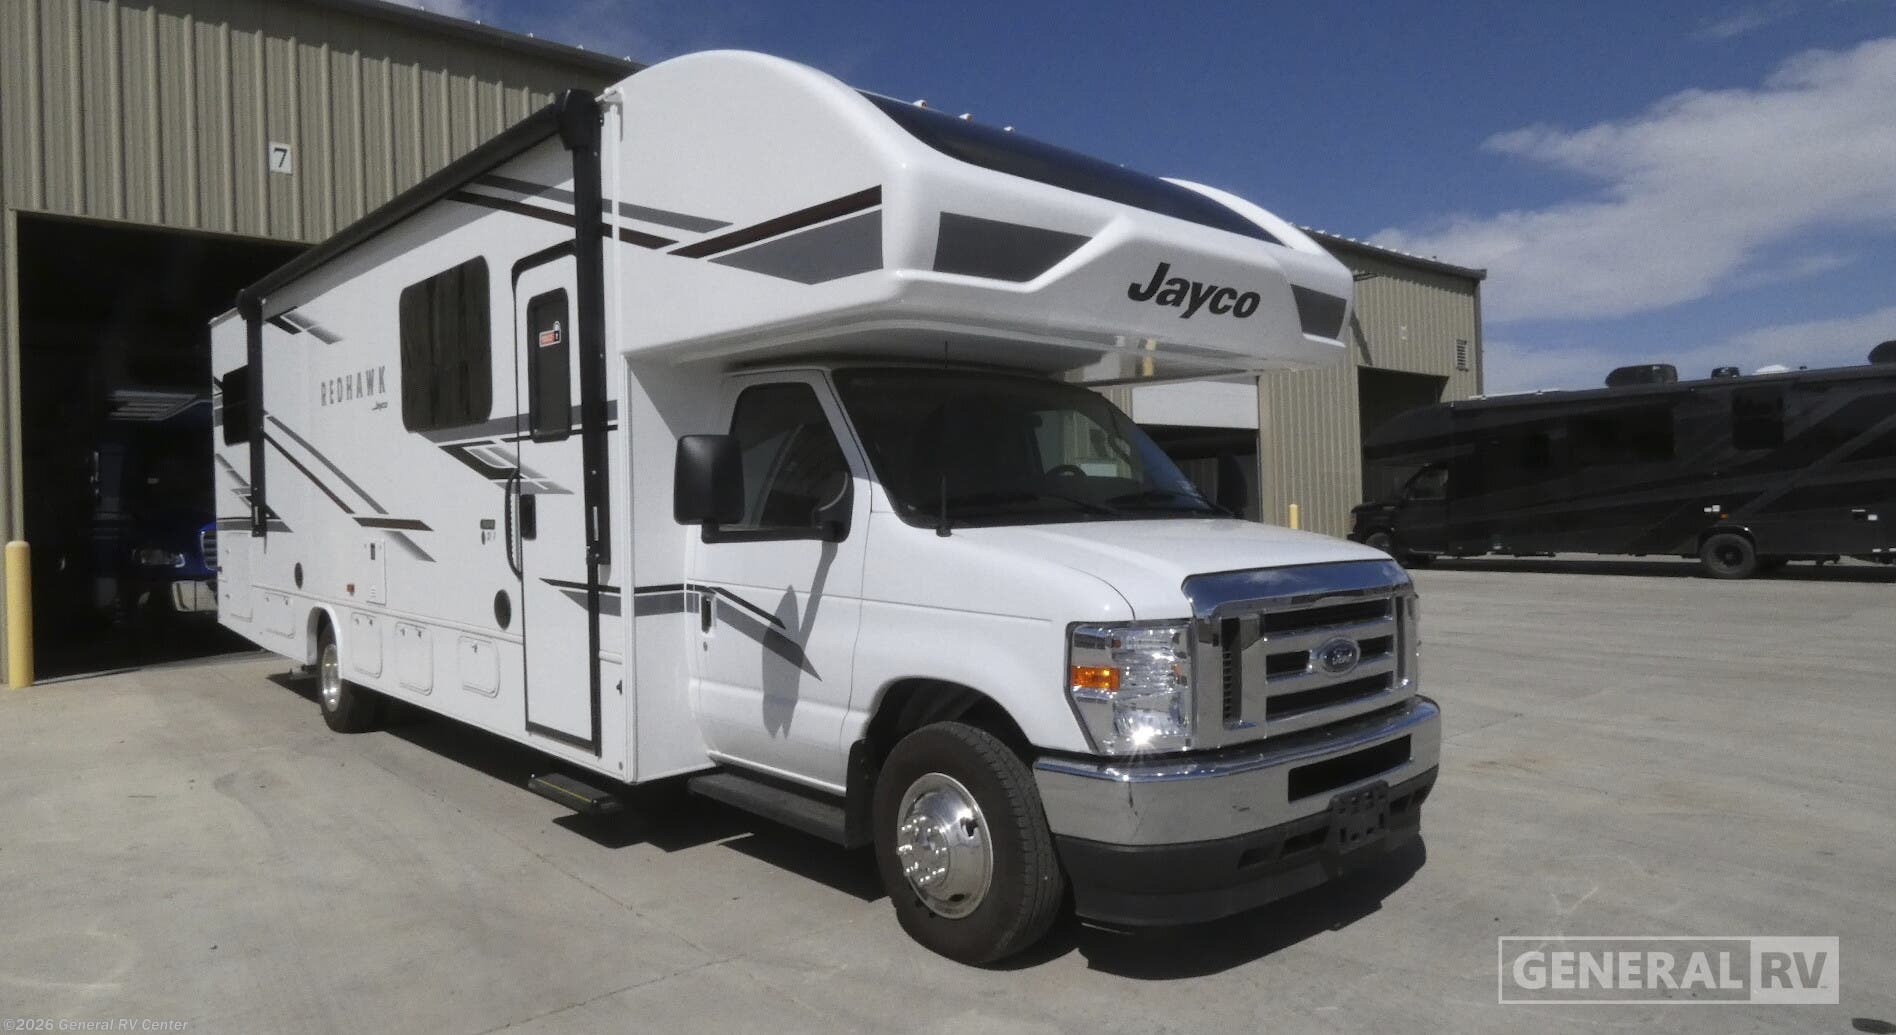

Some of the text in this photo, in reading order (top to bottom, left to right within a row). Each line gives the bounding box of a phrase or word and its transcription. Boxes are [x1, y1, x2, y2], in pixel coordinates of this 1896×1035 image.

[274, 147, 288, 168] 7
[1127, 261, 1261, 319] Jayco
[320, 365, 386, 407] REDHAWK
